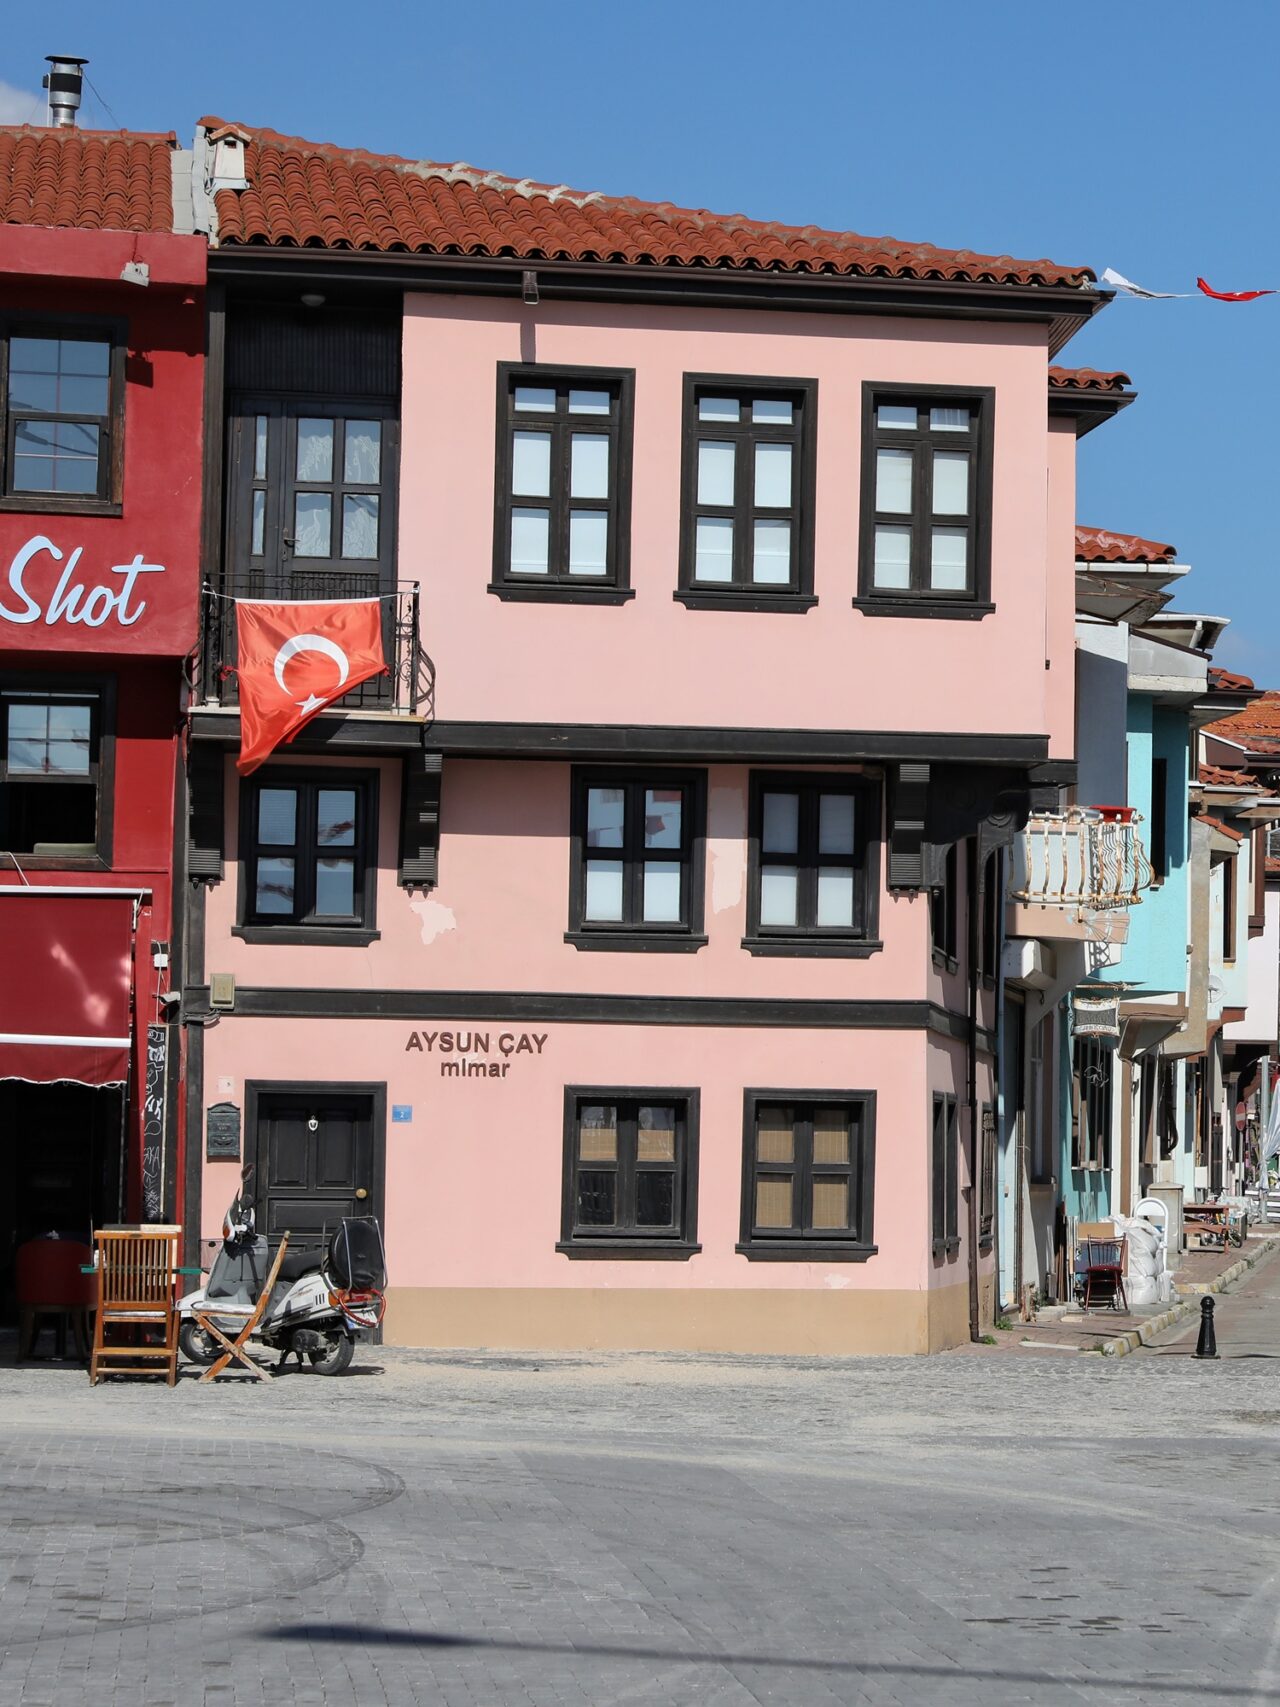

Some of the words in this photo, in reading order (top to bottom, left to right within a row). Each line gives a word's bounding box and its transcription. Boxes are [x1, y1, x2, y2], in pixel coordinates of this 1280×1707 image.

[0, 535, 166, 628] Shot
[405, 1031, 490, 1053] AYSUN
[498, 1033, 548, 1057] ÇAY
